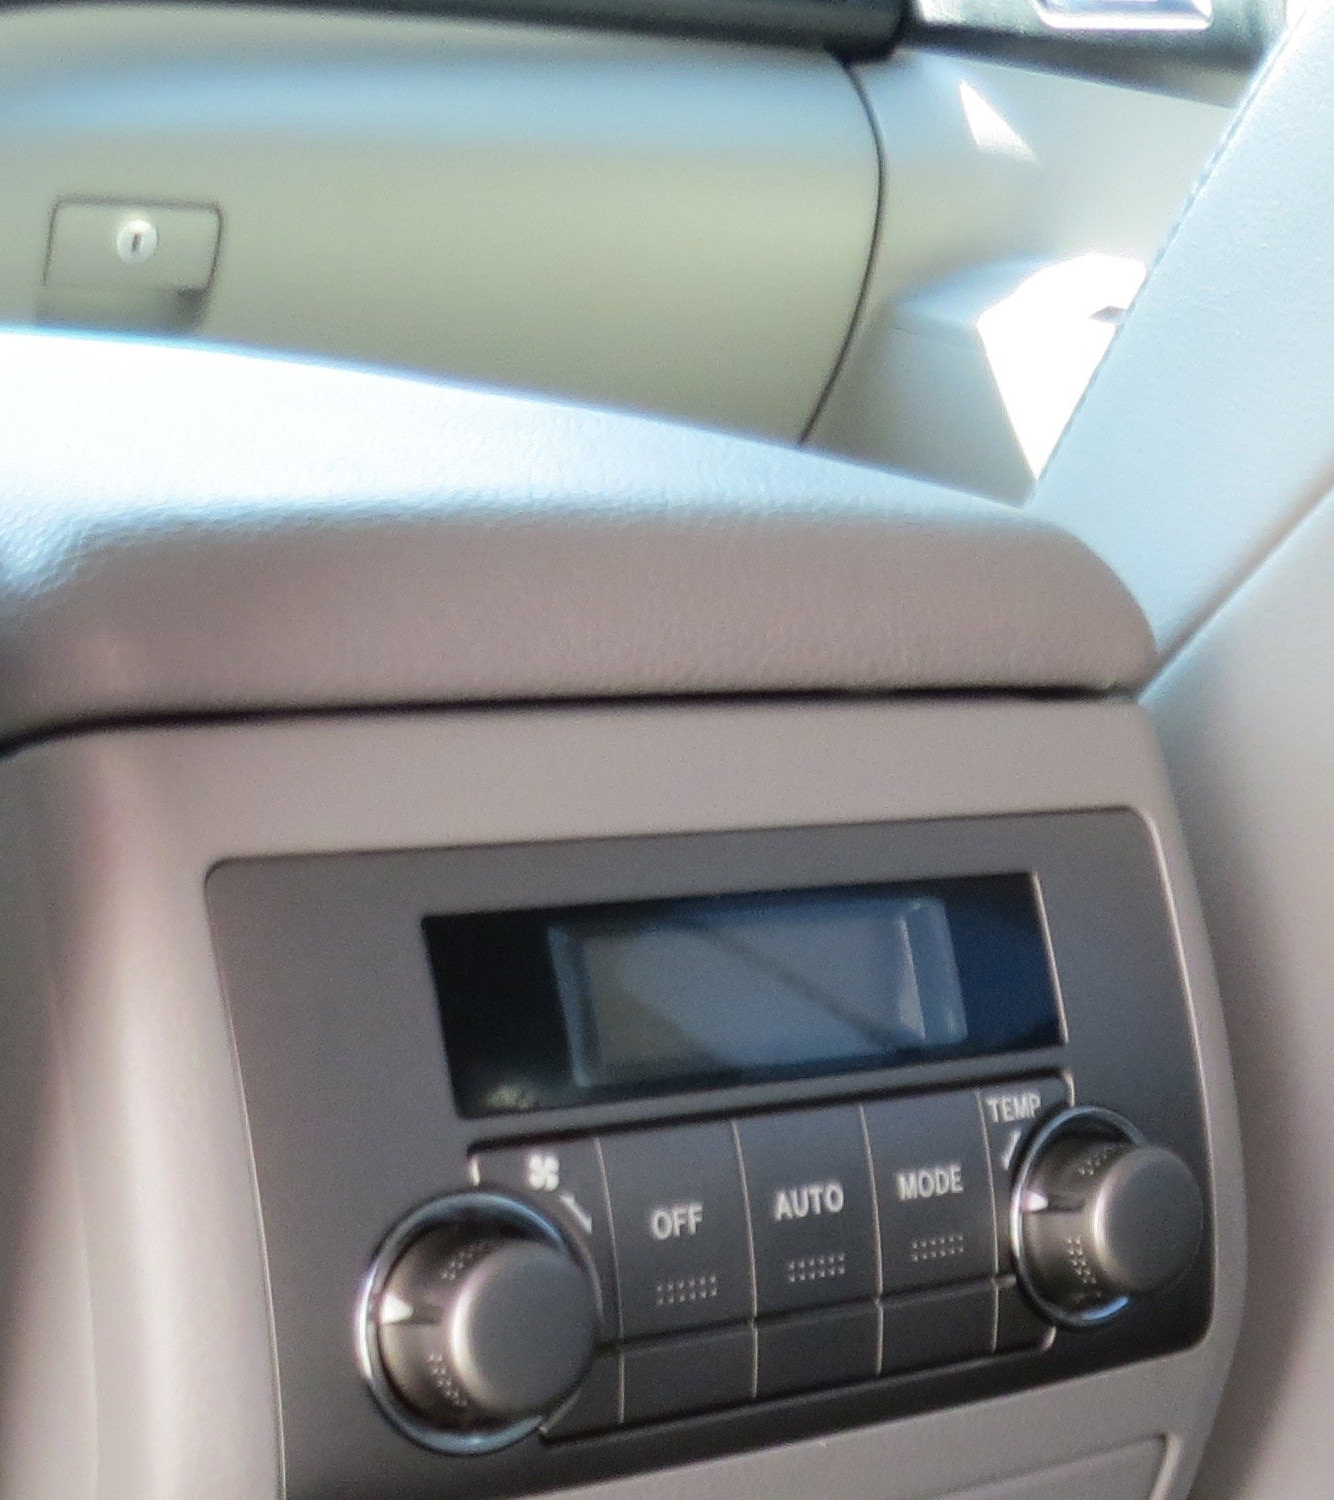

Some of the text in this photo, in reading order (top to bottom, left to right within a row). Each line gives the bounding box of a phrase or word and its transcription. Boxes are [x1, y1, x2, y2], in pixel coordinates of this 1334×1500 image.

[988, 1092, 1041, 1124] TEMP
[896, 1164, 964, 1202] MODE
[774, 1184, 845, 1221] AUTO
[649, 1203, 704, 1242] OFF
